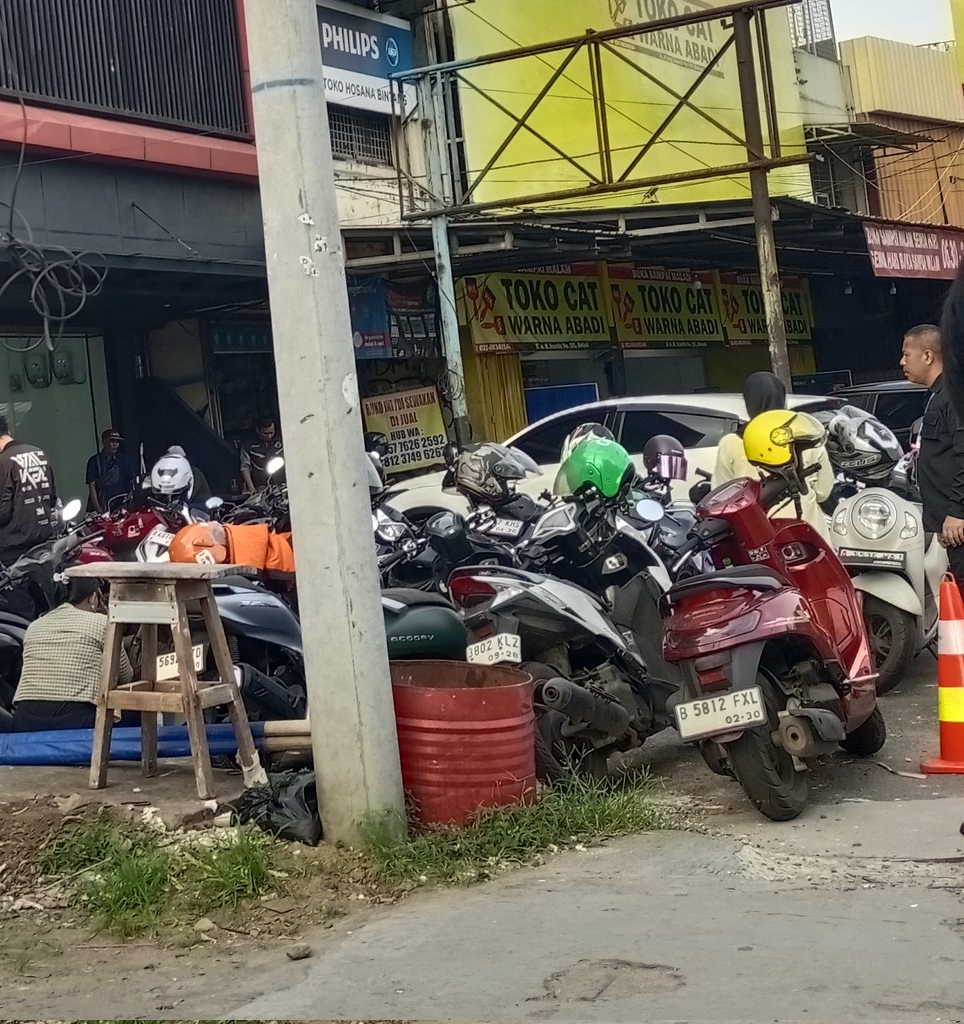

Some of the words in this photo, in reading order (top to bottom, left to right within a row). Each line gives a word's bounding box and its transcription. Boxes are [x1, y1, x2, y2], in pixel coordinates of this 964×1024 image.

[322, 22, 380, 60] PHILIPS
[324, 77, 344, 93] TOKO
[345, 83, 376, 100] HOSANA
[500, 278, 559, 310] TOKO
[564, 280, 599, 311] CAT
[638, 284, 682, 314] TOKO
[687, 287, 714, 315] CAT
[508, 315, 563, 335] WARNA
[566, 315, 606, 335] ABADI
[643, 317, 685, 335] WARNA
[687, 318, 719, 336] ABADI
[404, 391, 437, 409] SEWAKAN
[390, 415, 400, 427] DI
[400, 411, 419, 426] JUAL
[390, 430, 407, 441] HUB
[407, 427, 421, 439] WA
[397, 438, 420, 453] 7626
[421, 434, 445, 447] 2592
[401, 450, 422, 464] 3749
[497, 635, 519, 648] KLZ
[679, 707, 688, 720] B
[693, 697, 727, 717] 5812
[733, 691, 758, 708] FXL
